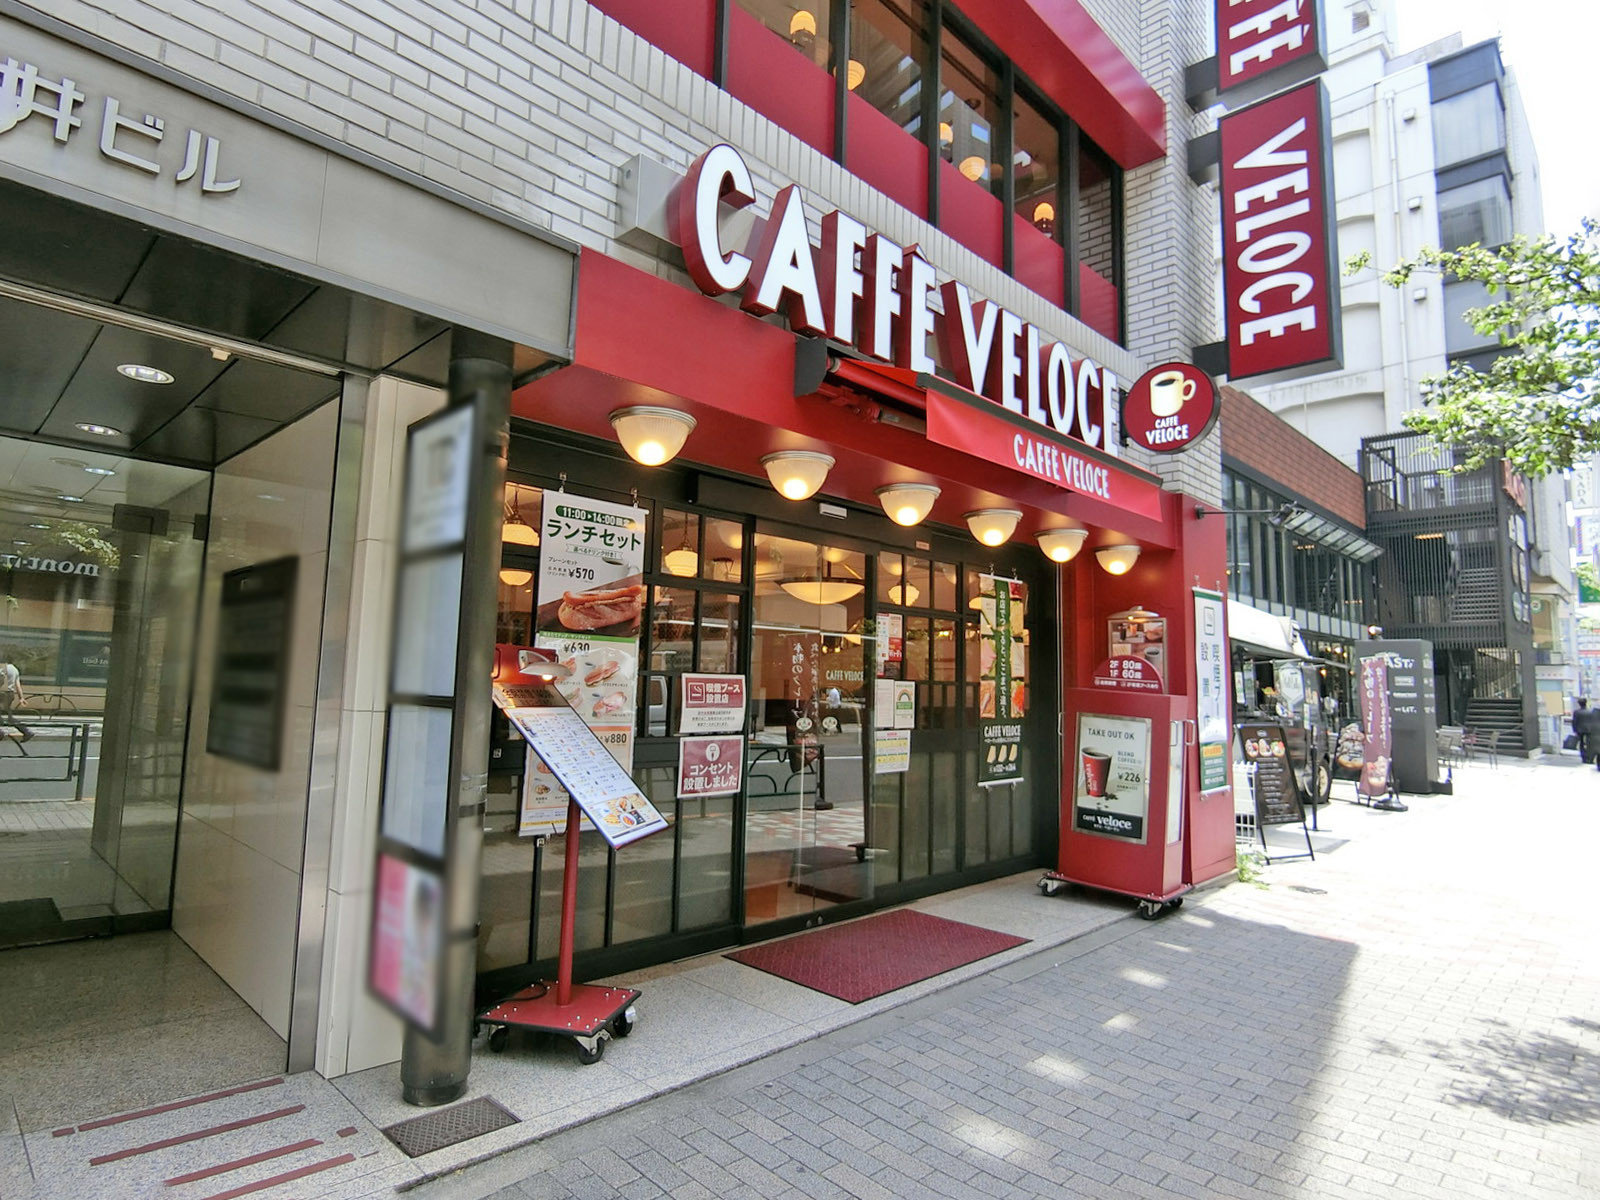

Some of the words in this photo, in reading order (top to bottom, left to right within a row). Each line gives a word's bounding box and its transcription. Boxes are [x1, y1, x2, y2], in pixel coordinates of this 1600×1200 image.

[0, 57, 241, 192] 井ビル
[1233, 117, 1317, 347] VELOCE
[953, 280, 1120, 457] VELOCE
[1145, 423, 1189, 445] VELOCE
[1061, 452, 1111, 499] VELOCE
[547, 519, 641, 551] ランチセット
[568, 567, 595, 580] ¥570
[1109, 660, 1119, 669] 2F
[1110, 669, 1119, 677] 1F
[604, 733, 627, 744] ¥880
[1088, 728, 1106, 737] TAKE
[1107, 730, 1122, 739] OUT
[1124, 732, 1135, 740] OK
[690, 762, 734, 775] コンセント
[683, 775, 737, 791] 設置しました
[1118, 772, 1141, 783] ¥226
[1097, 815, 1133, 830] veloce
